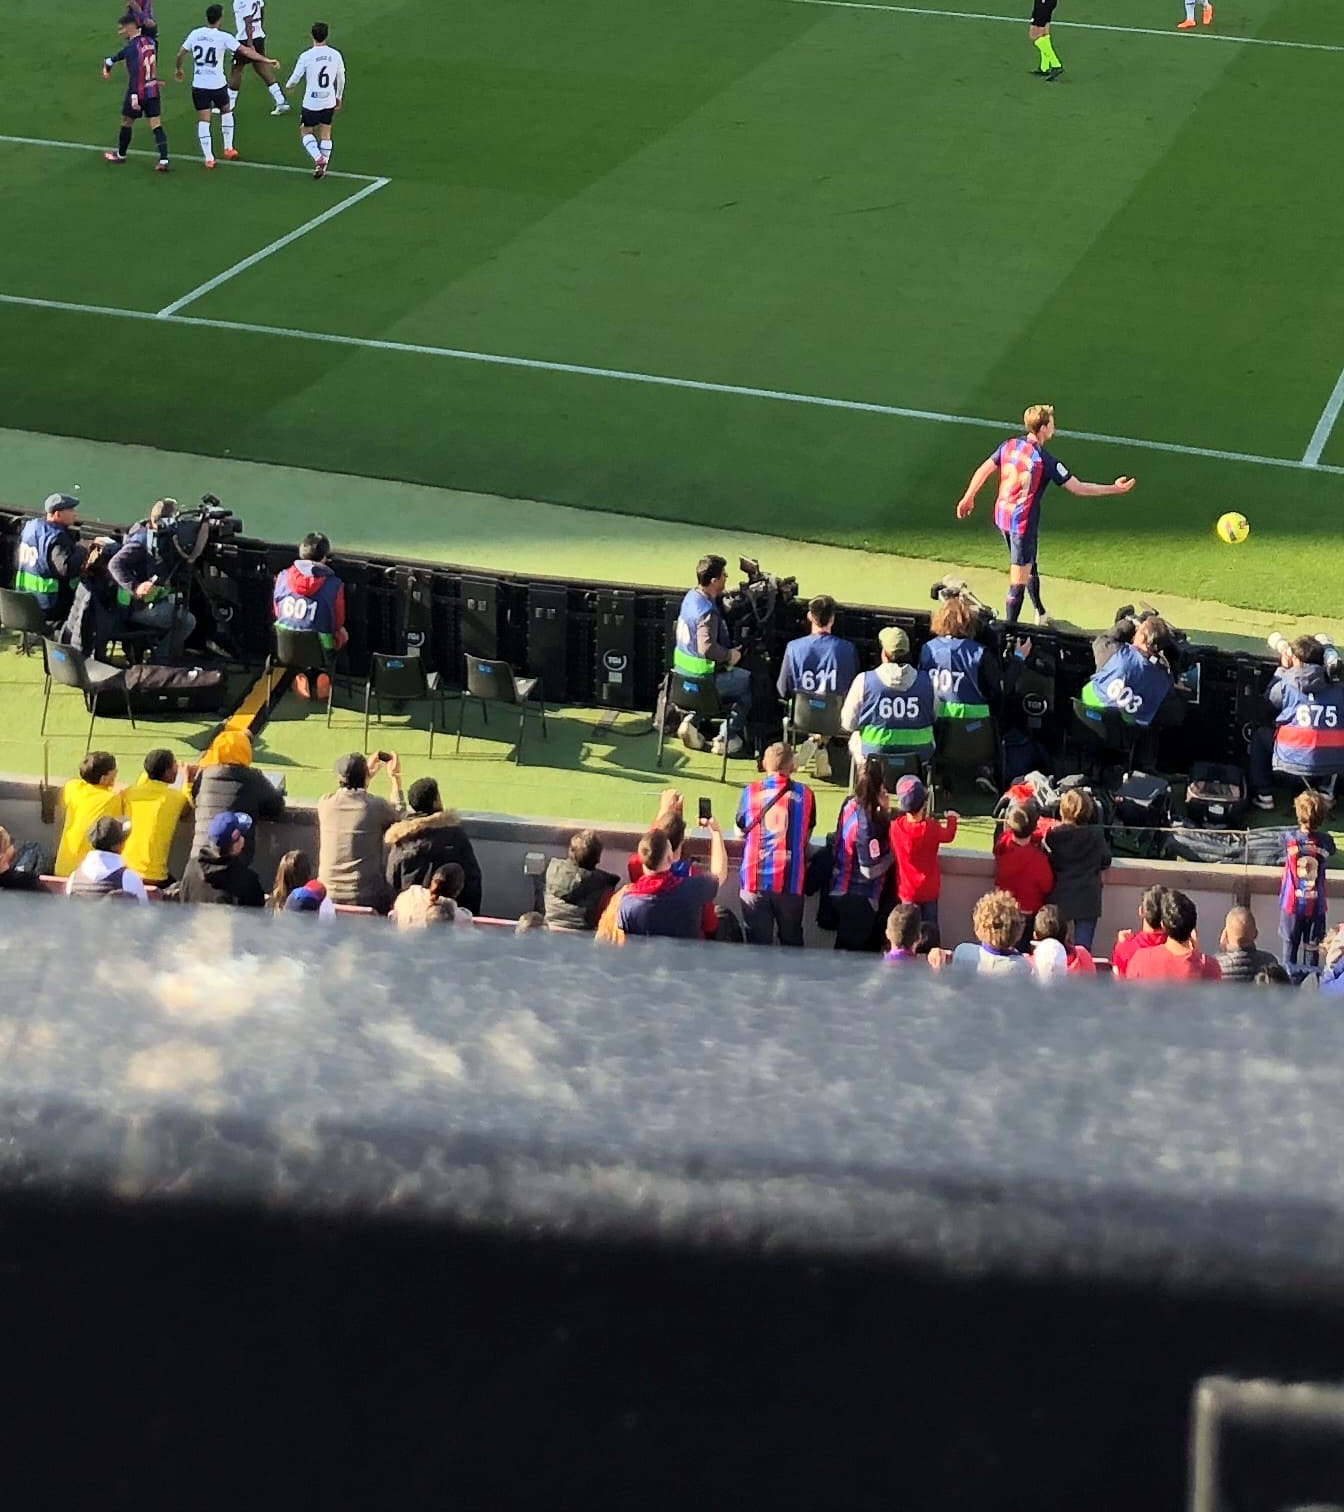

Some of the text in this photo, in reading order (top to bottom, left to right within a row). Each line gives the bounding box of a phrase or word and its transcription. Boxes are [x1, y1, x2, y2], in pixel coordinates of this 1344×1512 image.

[193, 44, 218, 67] 24
[318, 65, 330, 89] 6
[282, 595, 318, 622] 601
[879, 696, 920, 719] 605
[1105, 677, 1143, 714] 603
[1295, 704, 1338, 728] 675
